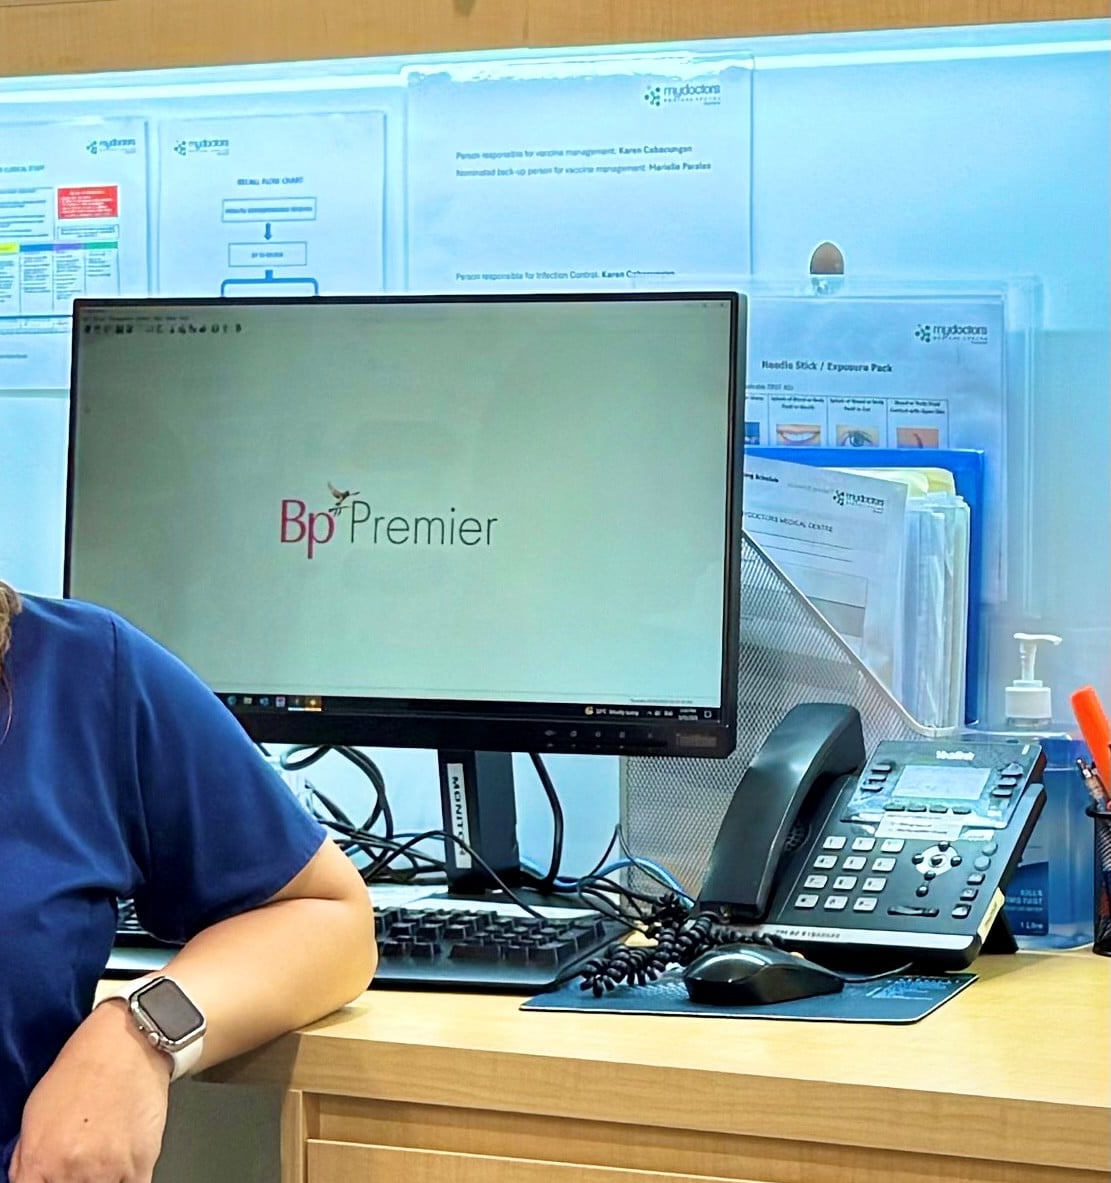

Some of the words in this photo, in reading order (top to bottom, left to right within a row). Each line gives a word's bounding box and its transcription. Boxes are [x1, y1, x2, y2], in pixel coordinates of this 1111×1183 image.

[762, 359, 793, 370] Needle
[795, 360, 817, 371] Stick
[827, 361, 869, 373] Exposure
[871, 363, 892, 373] Pack
[280, 499, 335, 559] Bp
[351, 500, 498, 546] Premier
